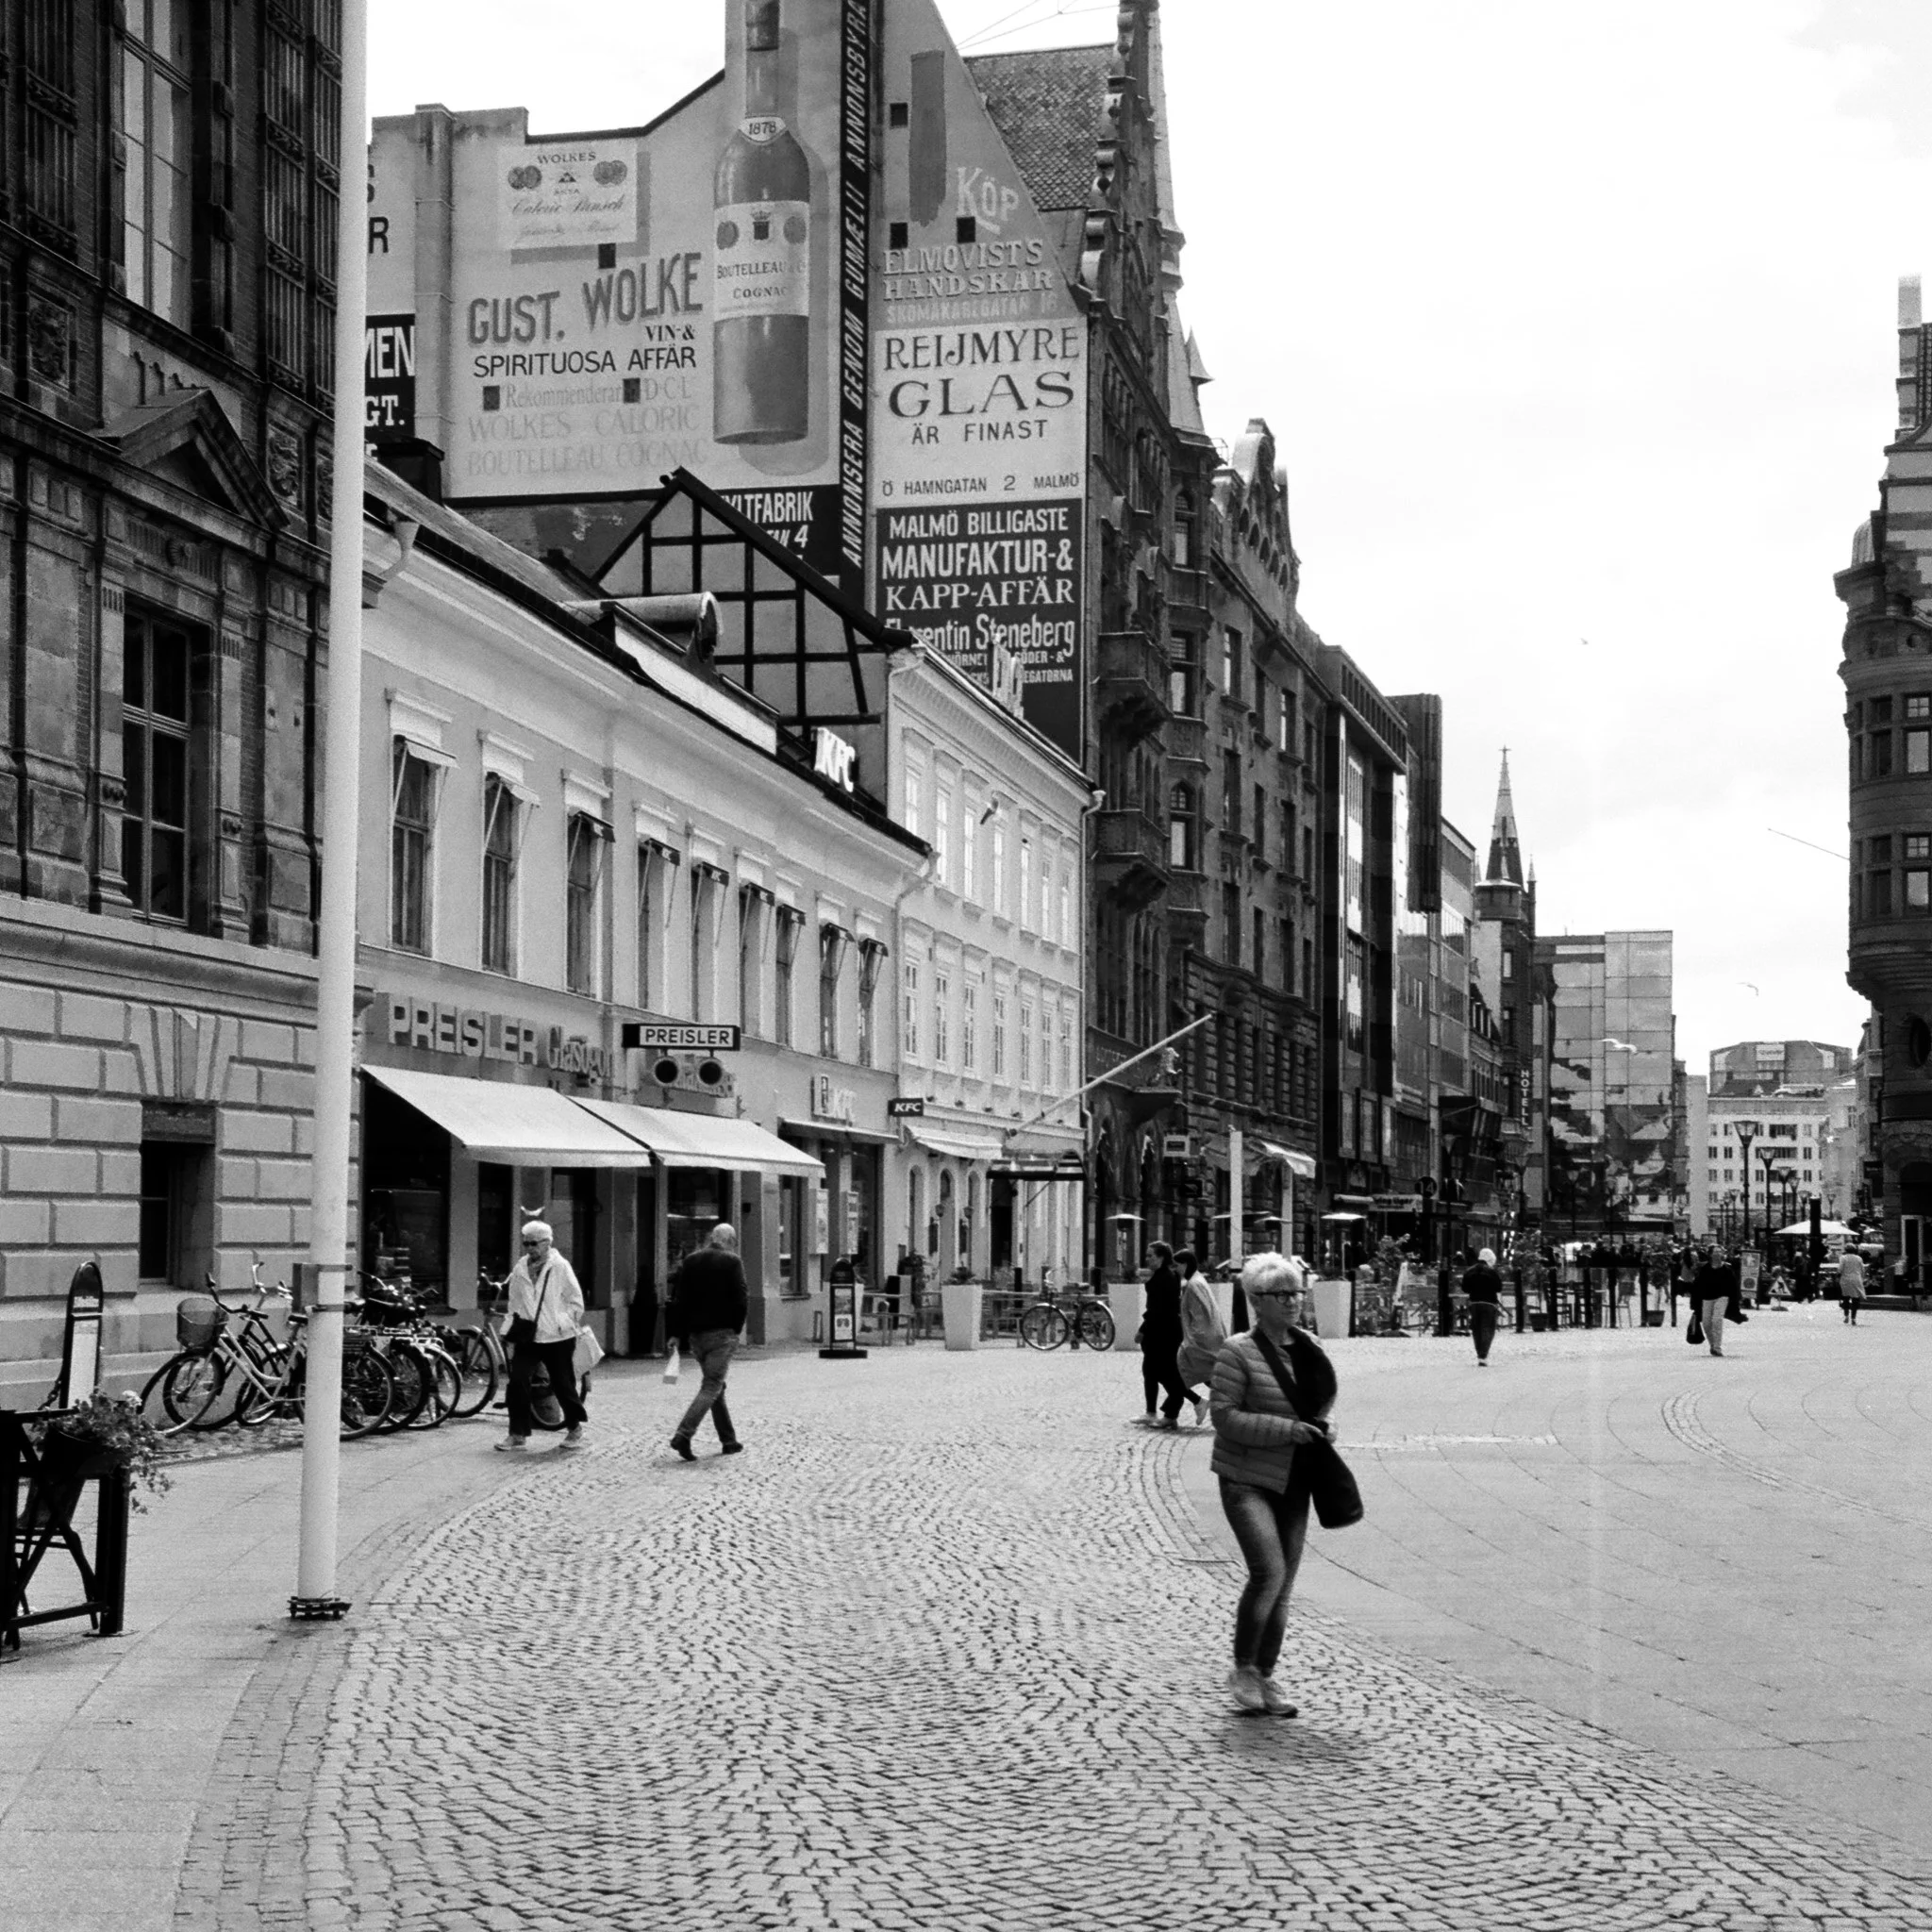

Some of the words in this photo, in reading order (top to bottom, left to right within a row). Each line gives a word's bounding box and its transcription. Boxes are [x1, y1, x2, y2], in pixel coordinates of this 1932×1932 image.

[748, 121, 777, 136] 1878
[537, 150, 597, 164] WOLKES
[957, 167, 1020, 234] KÖP
[469, 290, 566, 346] GUST.
[582, 252, 704, 331] WOLKE
[733, 286, 789, 300] COGNAC
[474, 350, 617, 377] SPIRITUOSA
[627, 343, 697, 371] AFFÄR
[843, 307, 864, 410] GENOM
[884, 326, 1080, 371] REIJMYRE
[889, 370, 1074, 418] GLAS
[468, 411, 572, 441] WOLKES
[594, 404, 701, 437] CALORIC
[911, 423, 940, 445] ÄR
[964, 419, 1048, 442] FINAST
[467, 443, 605, 477] BOUTELLEAU
[615, 437, 709, 468] COGNAC
[842, 419, 863, 568] ANNONSERA
[882, 480, 893, 497] Ö
[904, 477, 988, 495] HAMNGATAN
[1003, 475, 1016, 491] 2
[1033, 472, 1080, 490] MALMÖ
[793, 525, 809, 549] 4
[890, 509, 959, 539] MALMÖ
[967, 507, 1069, 536] BILLIGASTE
[885, 575, 1075, 611] KAPP-AFFÄR
[975, 612, 1075, 658] Steneberg
[389, 992, 539, 1066] PREISLER
[644, 1028, 730, 1045] PREISLER
[893, 1102, 923, 1112] KFC
[1520, 1069, 1530, 1126] HOTELL
